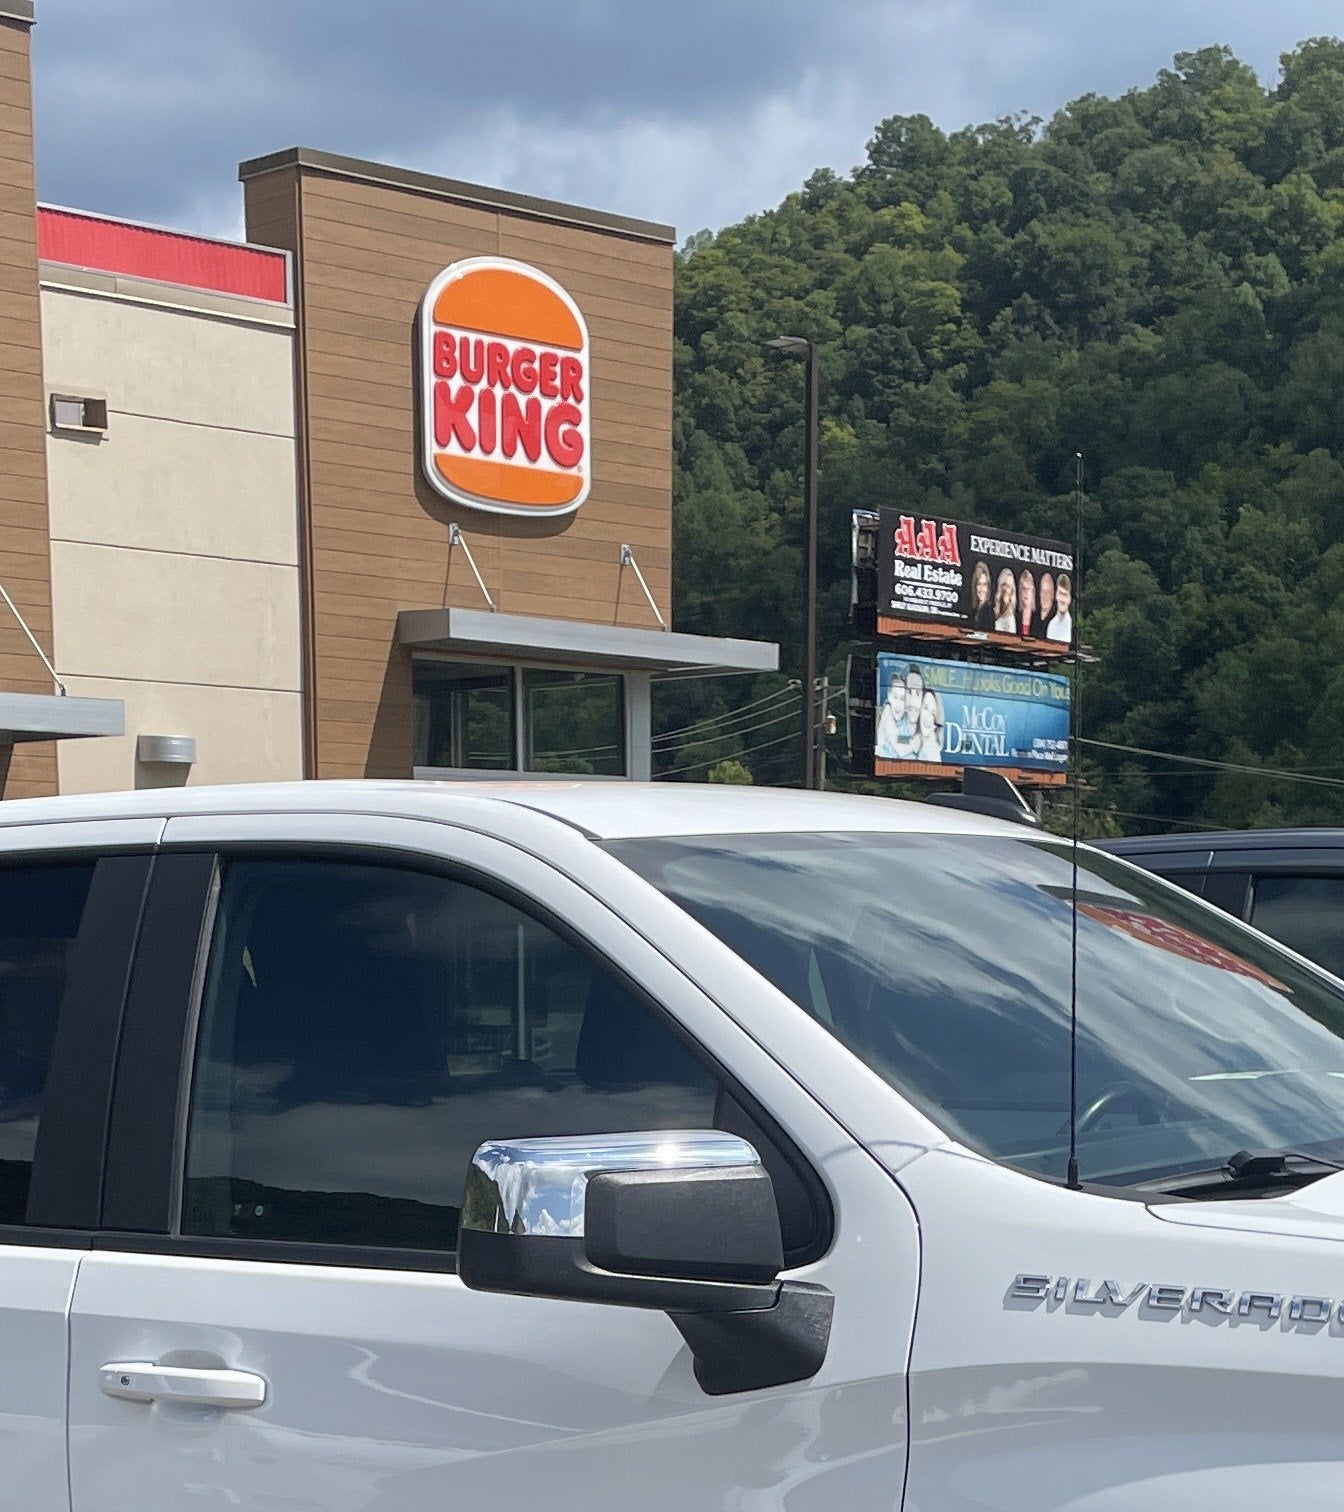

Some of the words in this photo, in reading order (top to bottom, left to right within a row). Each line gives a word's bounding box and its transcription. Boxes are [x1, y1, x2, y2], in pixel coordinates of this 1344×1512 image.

[433, 331, 584, 404] BURGER
[433, 380, 584, 469] KING
[970, 534, 1031, 562] EXPERIENCE
[1031, 547, 1073, 571] MATTERS
[894, 559, 922, 580] Real
[923, 564, 963, 587] Estate
[944, 721, 1010, 757] DENTAL
